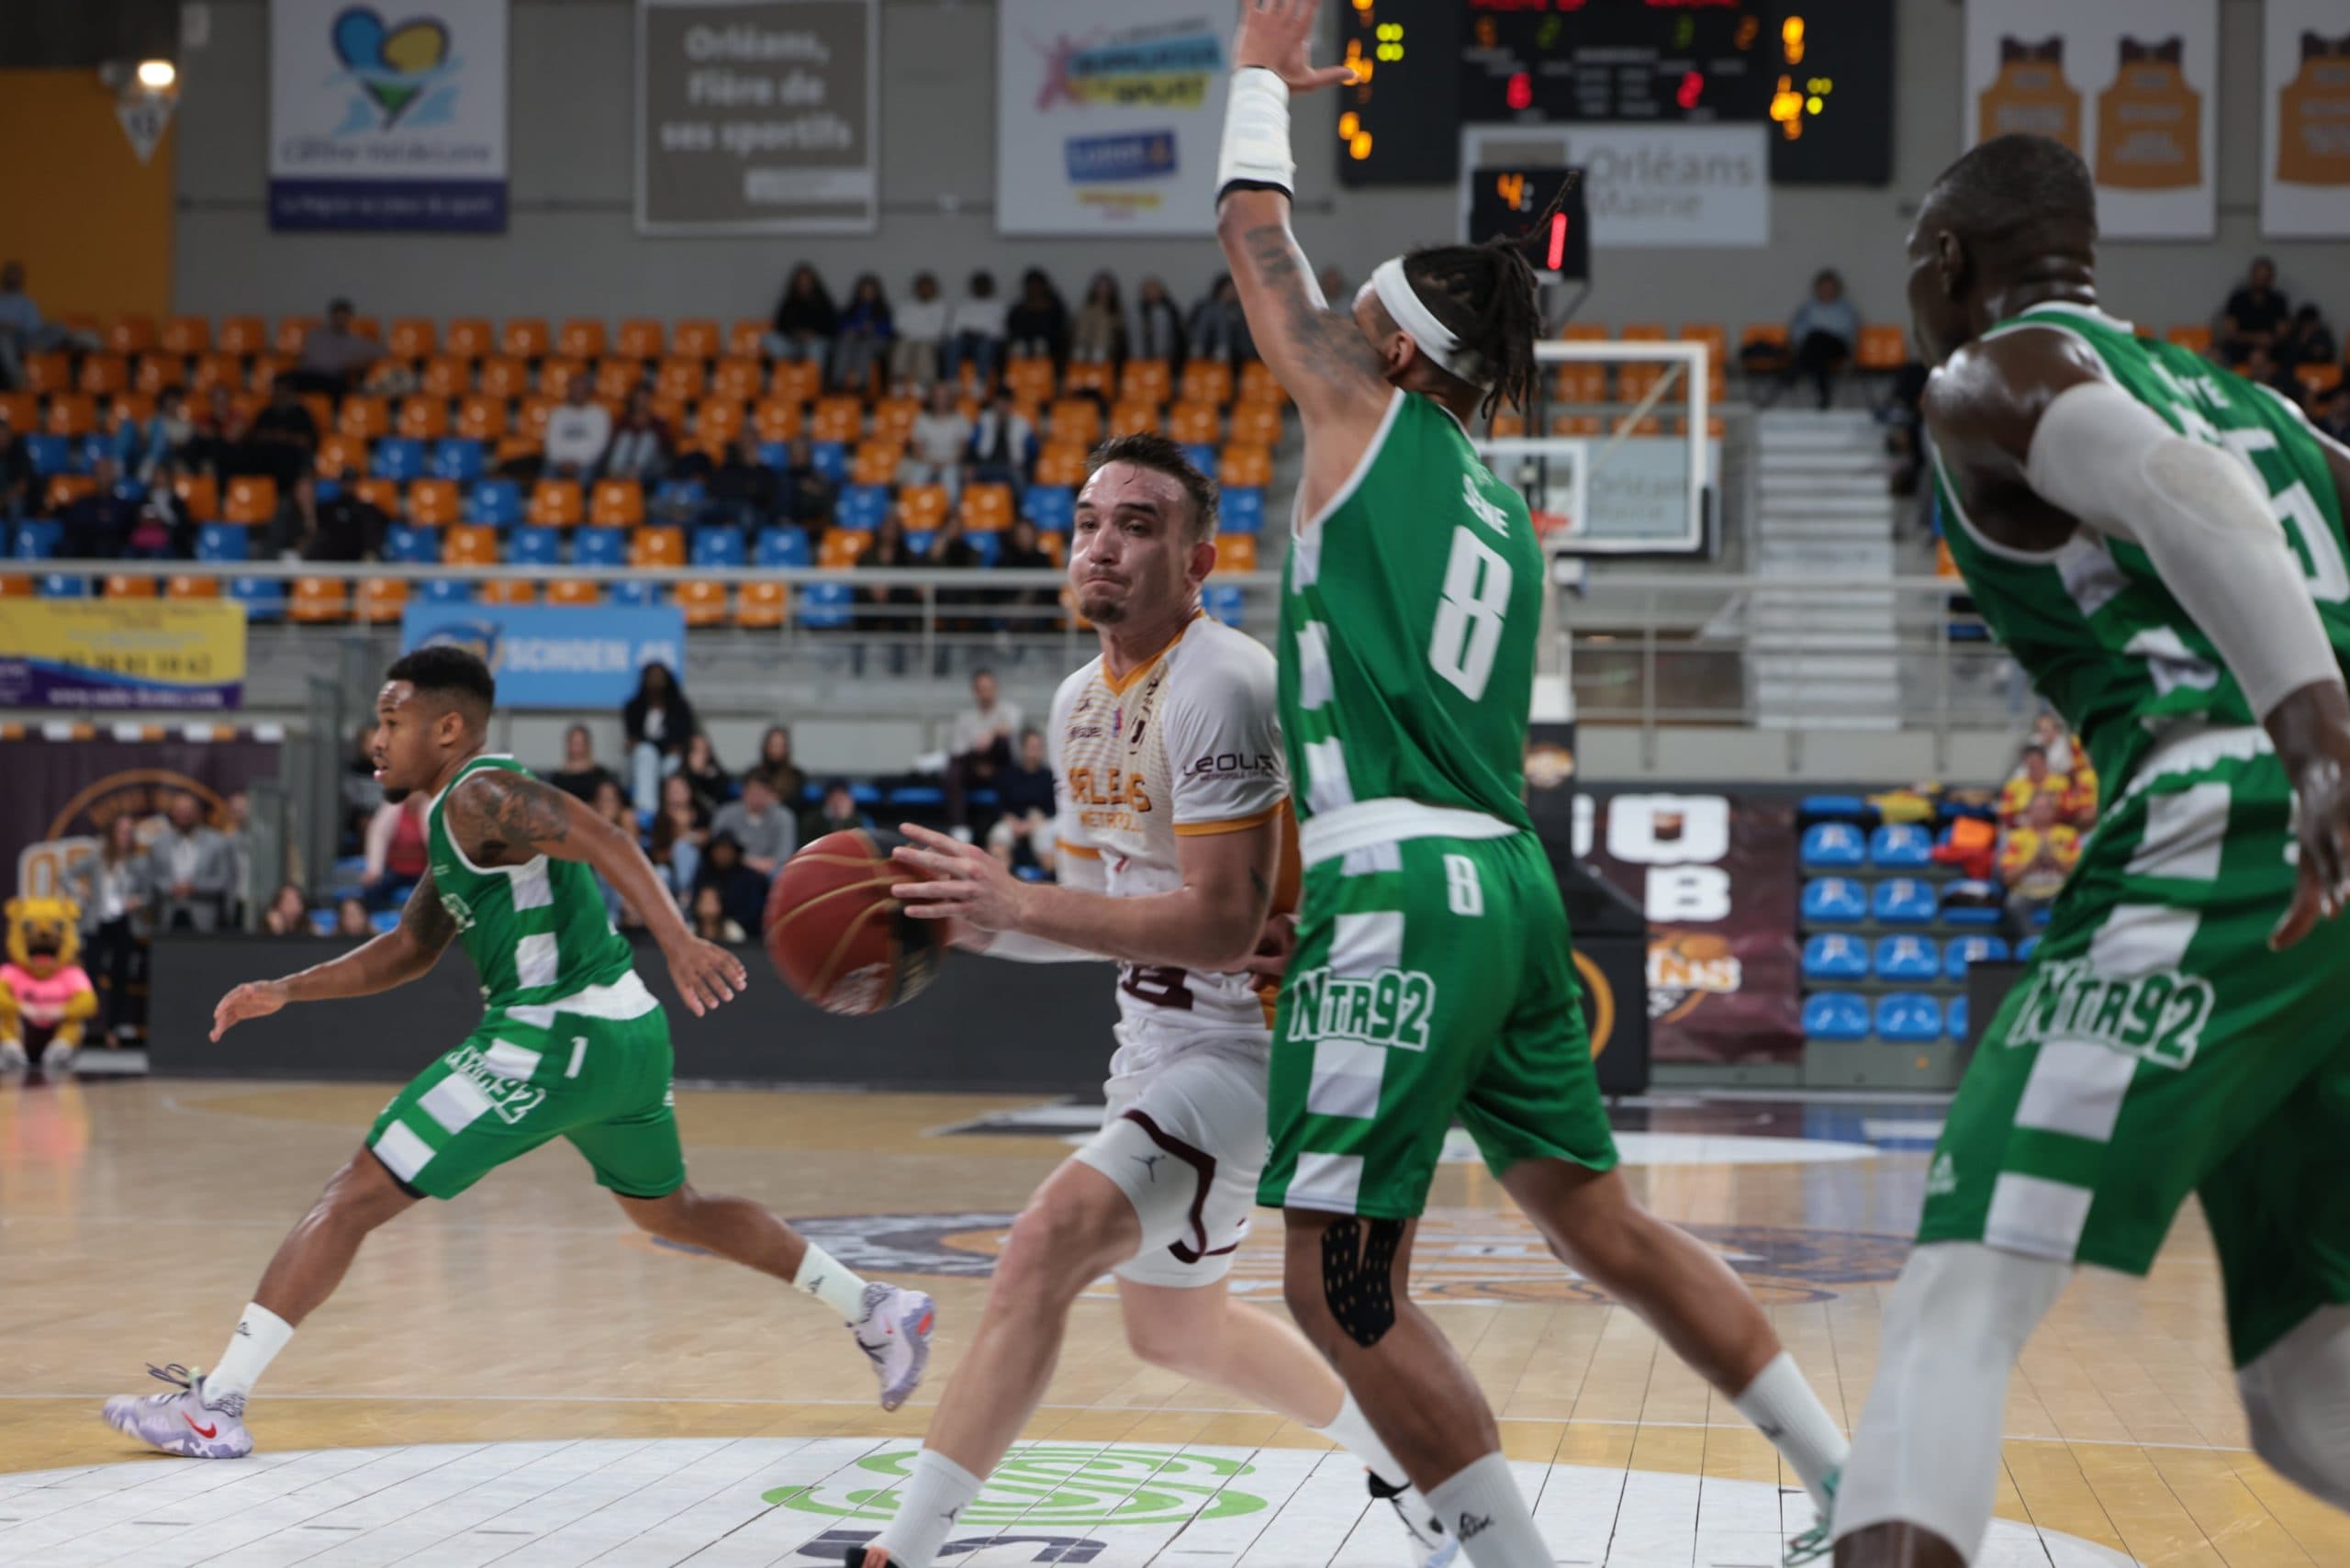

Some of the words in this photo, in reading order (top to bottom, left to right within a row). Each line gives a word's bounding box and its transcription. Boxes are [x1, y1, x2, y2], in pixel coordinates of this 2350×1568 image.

[779, 66, 826, 106] de
[721, 111, 853, 160] sportifs
[1586, 147, 1754, 187] Orléans
[1428, 525, 1513, 702] 8
[1442, 854, 1484, 916] 8
[565, 1036, 588, 1079] 1
